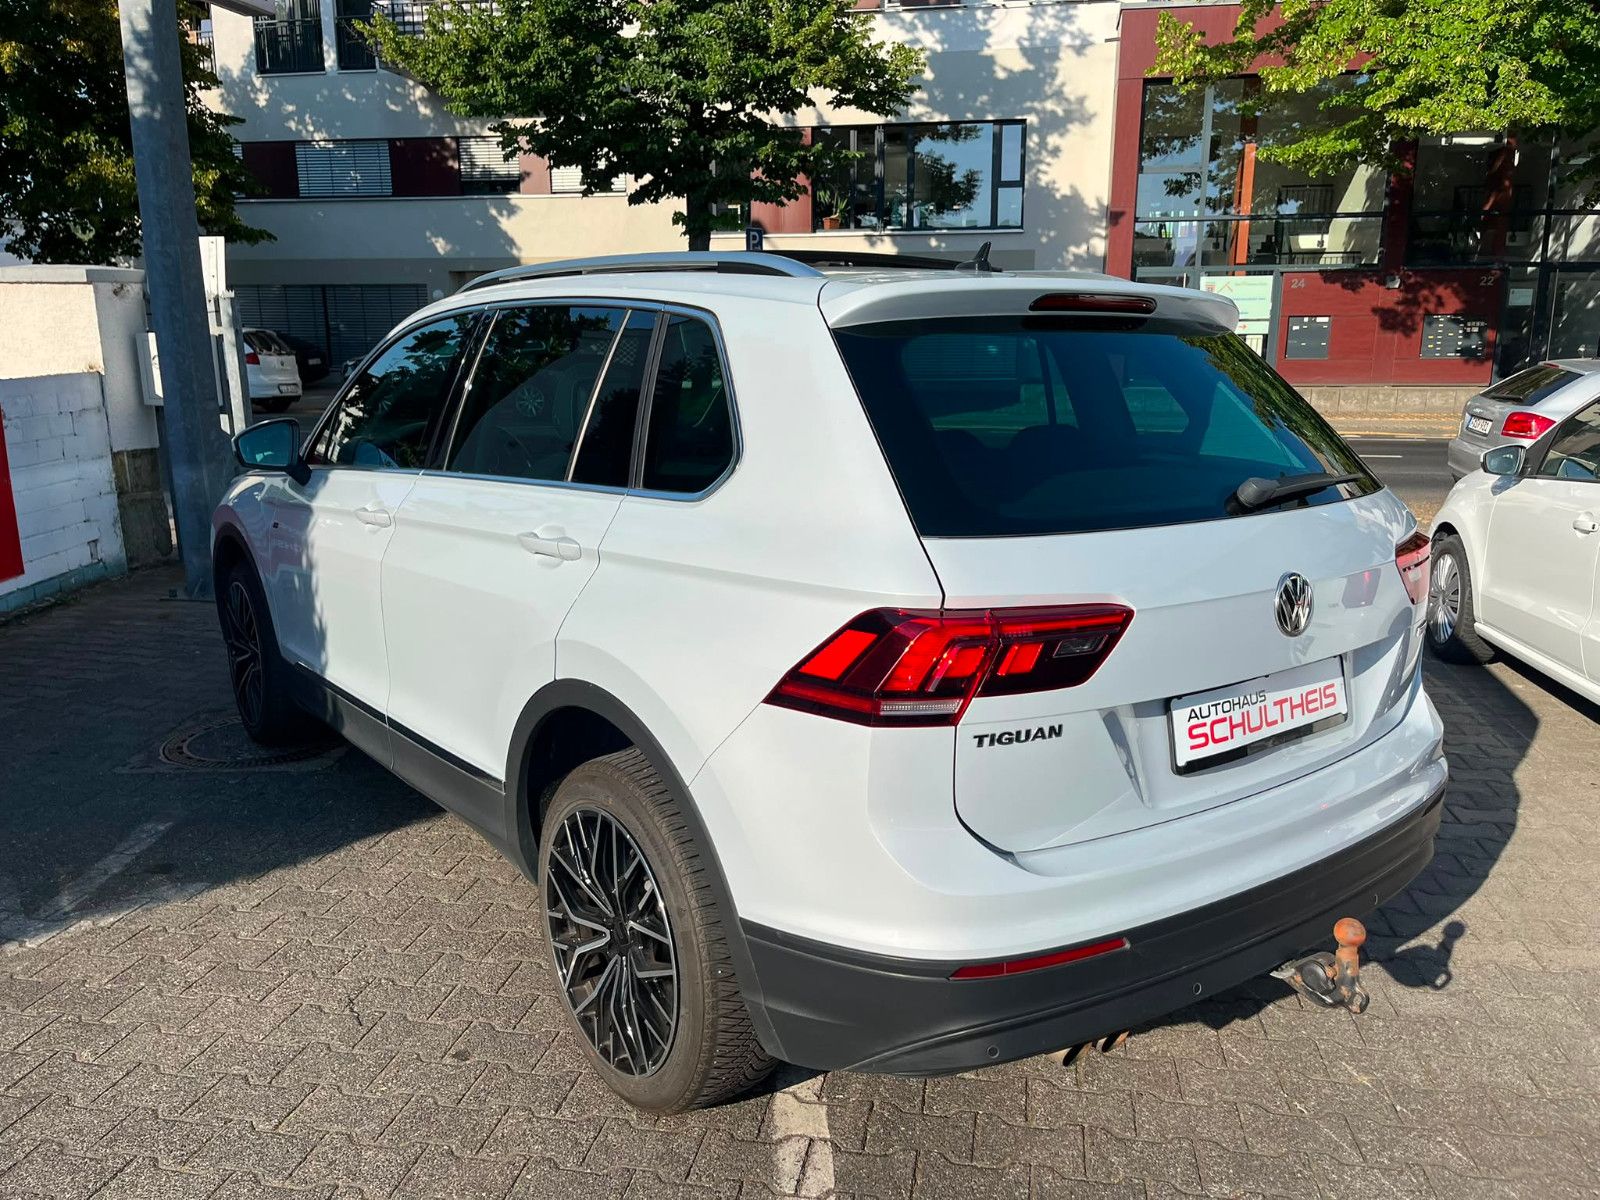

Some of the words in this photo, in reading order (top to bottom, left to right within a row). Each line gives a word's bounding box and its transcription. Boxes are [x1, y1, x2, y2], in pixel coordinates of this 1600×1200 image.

[750, 231, 760, 250] P
[1291, 278, 1305, 289] 24
[1480, 276, 1495, 286] 22
[1187, 689, 1267, 722] AUTOHAUS
[1188, 683, 1337, 750] SCHULTHEIS
[973, 723, 1063, 748] TIGUAN
